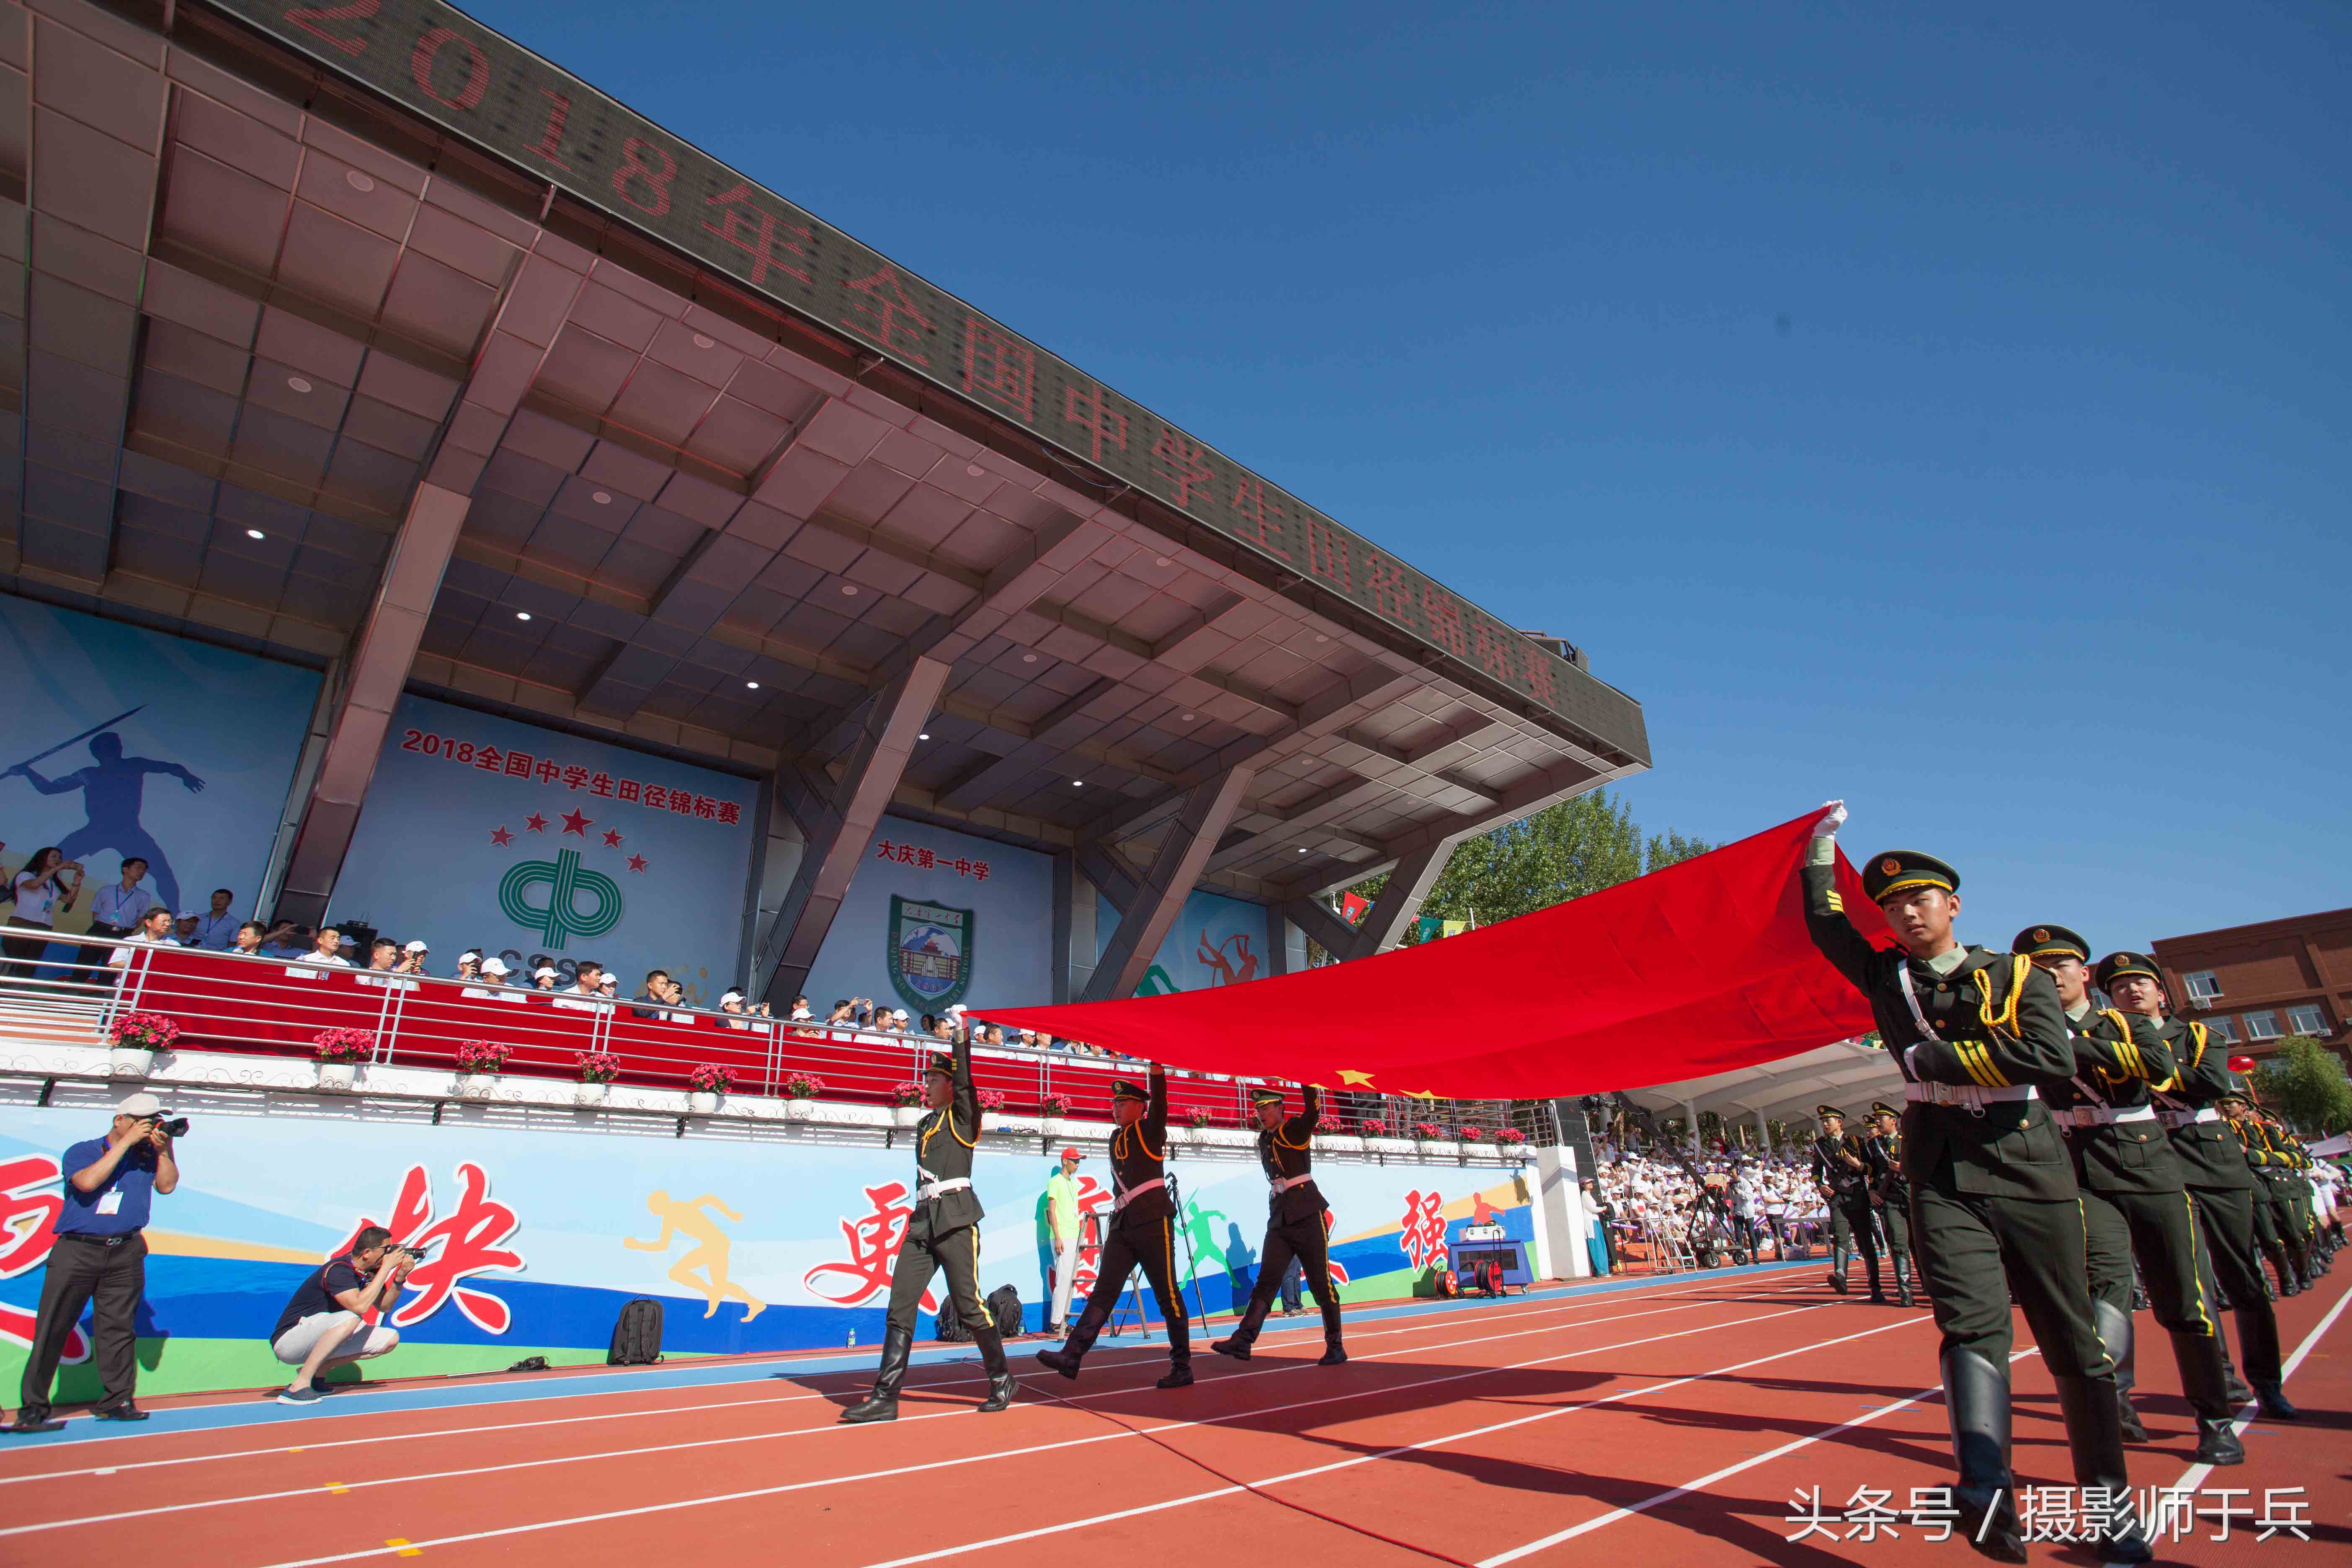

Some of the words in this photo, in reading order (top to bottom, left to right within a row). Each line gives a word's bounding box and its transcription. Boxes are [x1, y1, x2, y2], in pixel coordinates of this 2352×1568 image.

[402, 730, 742, 826] 2018全国中学生田径锦标赛
[877, 839, 990, 880] 大庆第一中学
